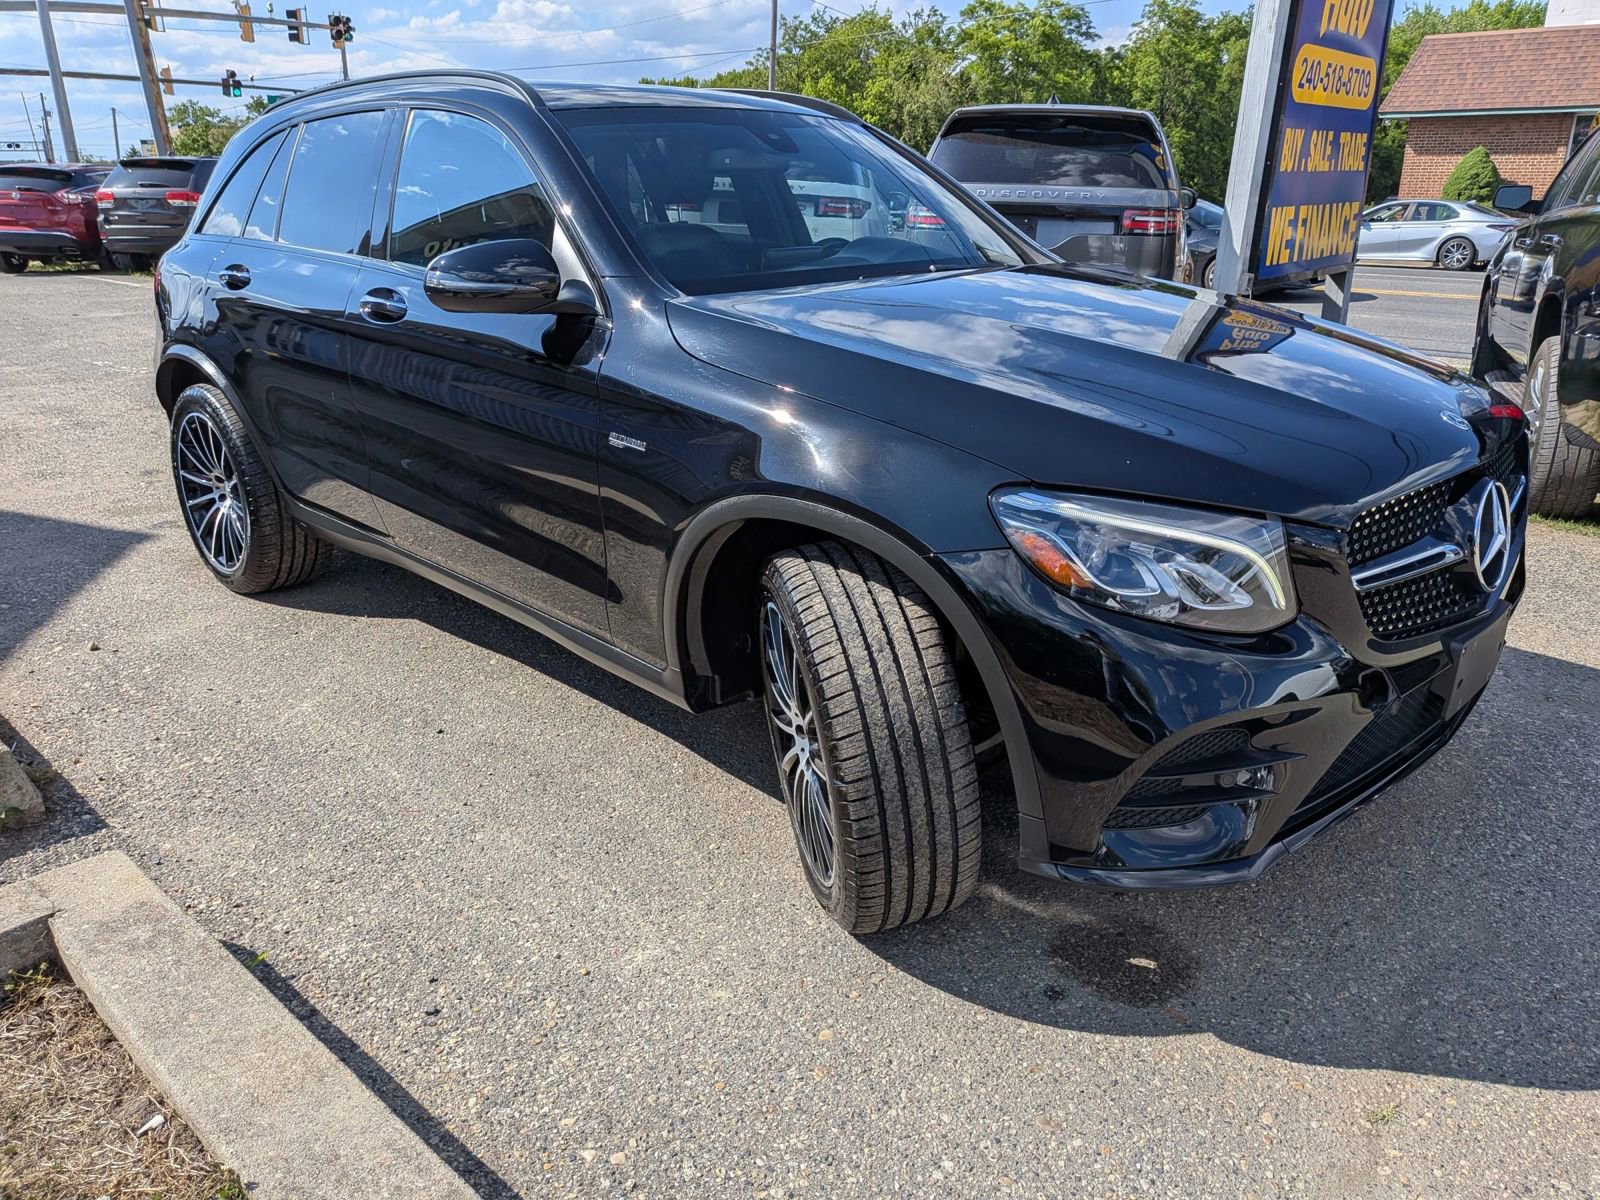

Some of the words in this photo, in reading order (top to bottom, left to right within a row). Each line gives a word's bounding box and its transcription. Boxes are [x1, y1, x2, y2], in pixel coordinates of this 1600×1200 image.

[1297, 57, 1371, 98] 240-518-8709
[1338, 132, 1368, 171] TRADE
[976, 189, 1105, 199] DISCOVERY
[1265, 205, 1296, 266] WE
[1293, 201, 1360, 262] FINANCE
